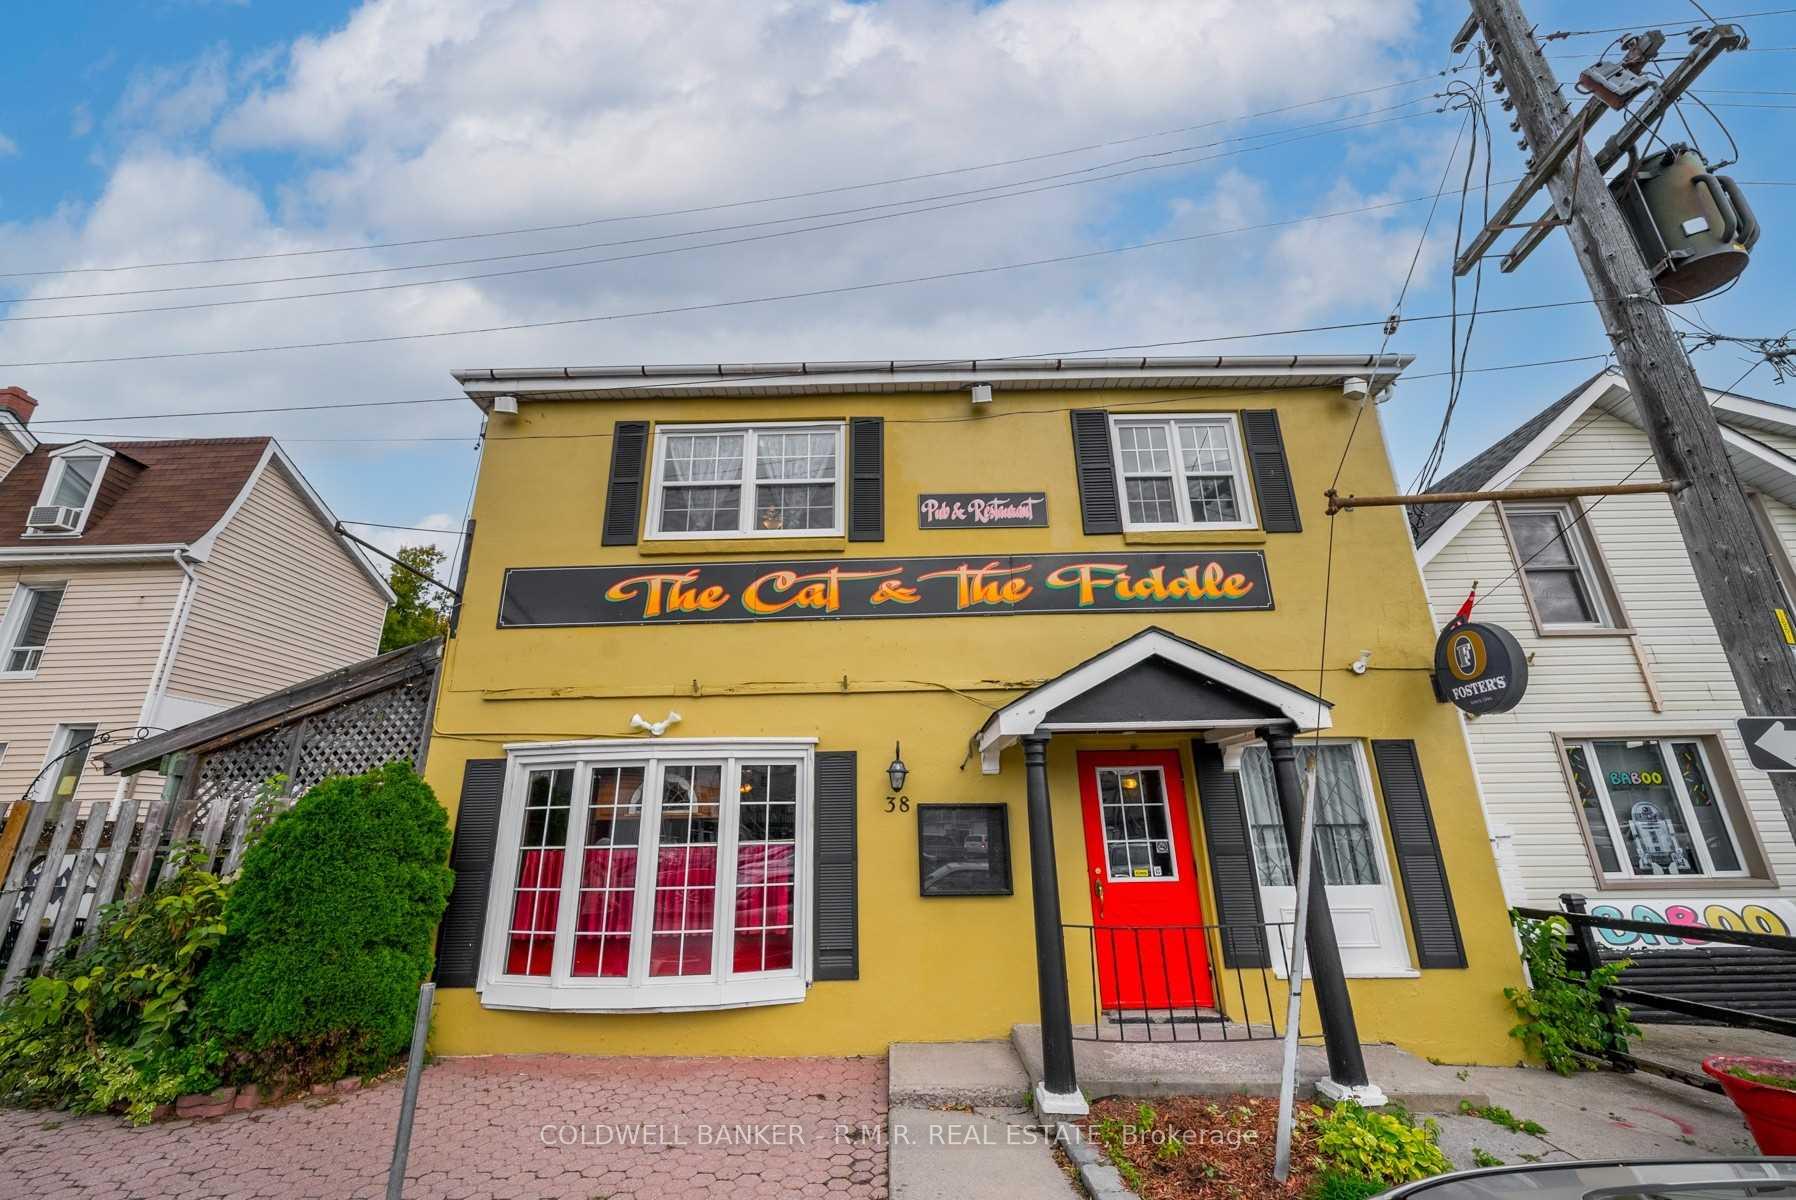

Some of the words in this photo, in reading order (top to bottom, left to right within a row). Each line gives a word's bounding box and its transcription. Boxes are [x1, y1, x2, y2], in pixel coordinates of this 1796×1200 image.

[921, 499, 950, 522] Pub
[951, 502, 967, 520] &
[605, 568, 731, 618] The
[741, 566, 903, 615] Cat
[870, 579, 922, 604] &
[916, 561, 1033, 611] The
[1044, 562, 1254, 608] Fiddle
[1456, 643, 1472, 669] F
[1451, 675, 1507, 700] FOSTER'S
[1609, 771, 1663, 785] BABOO
[884, 796, 910, 813] 38
[1591, 904, 1792, 946] BABOO
